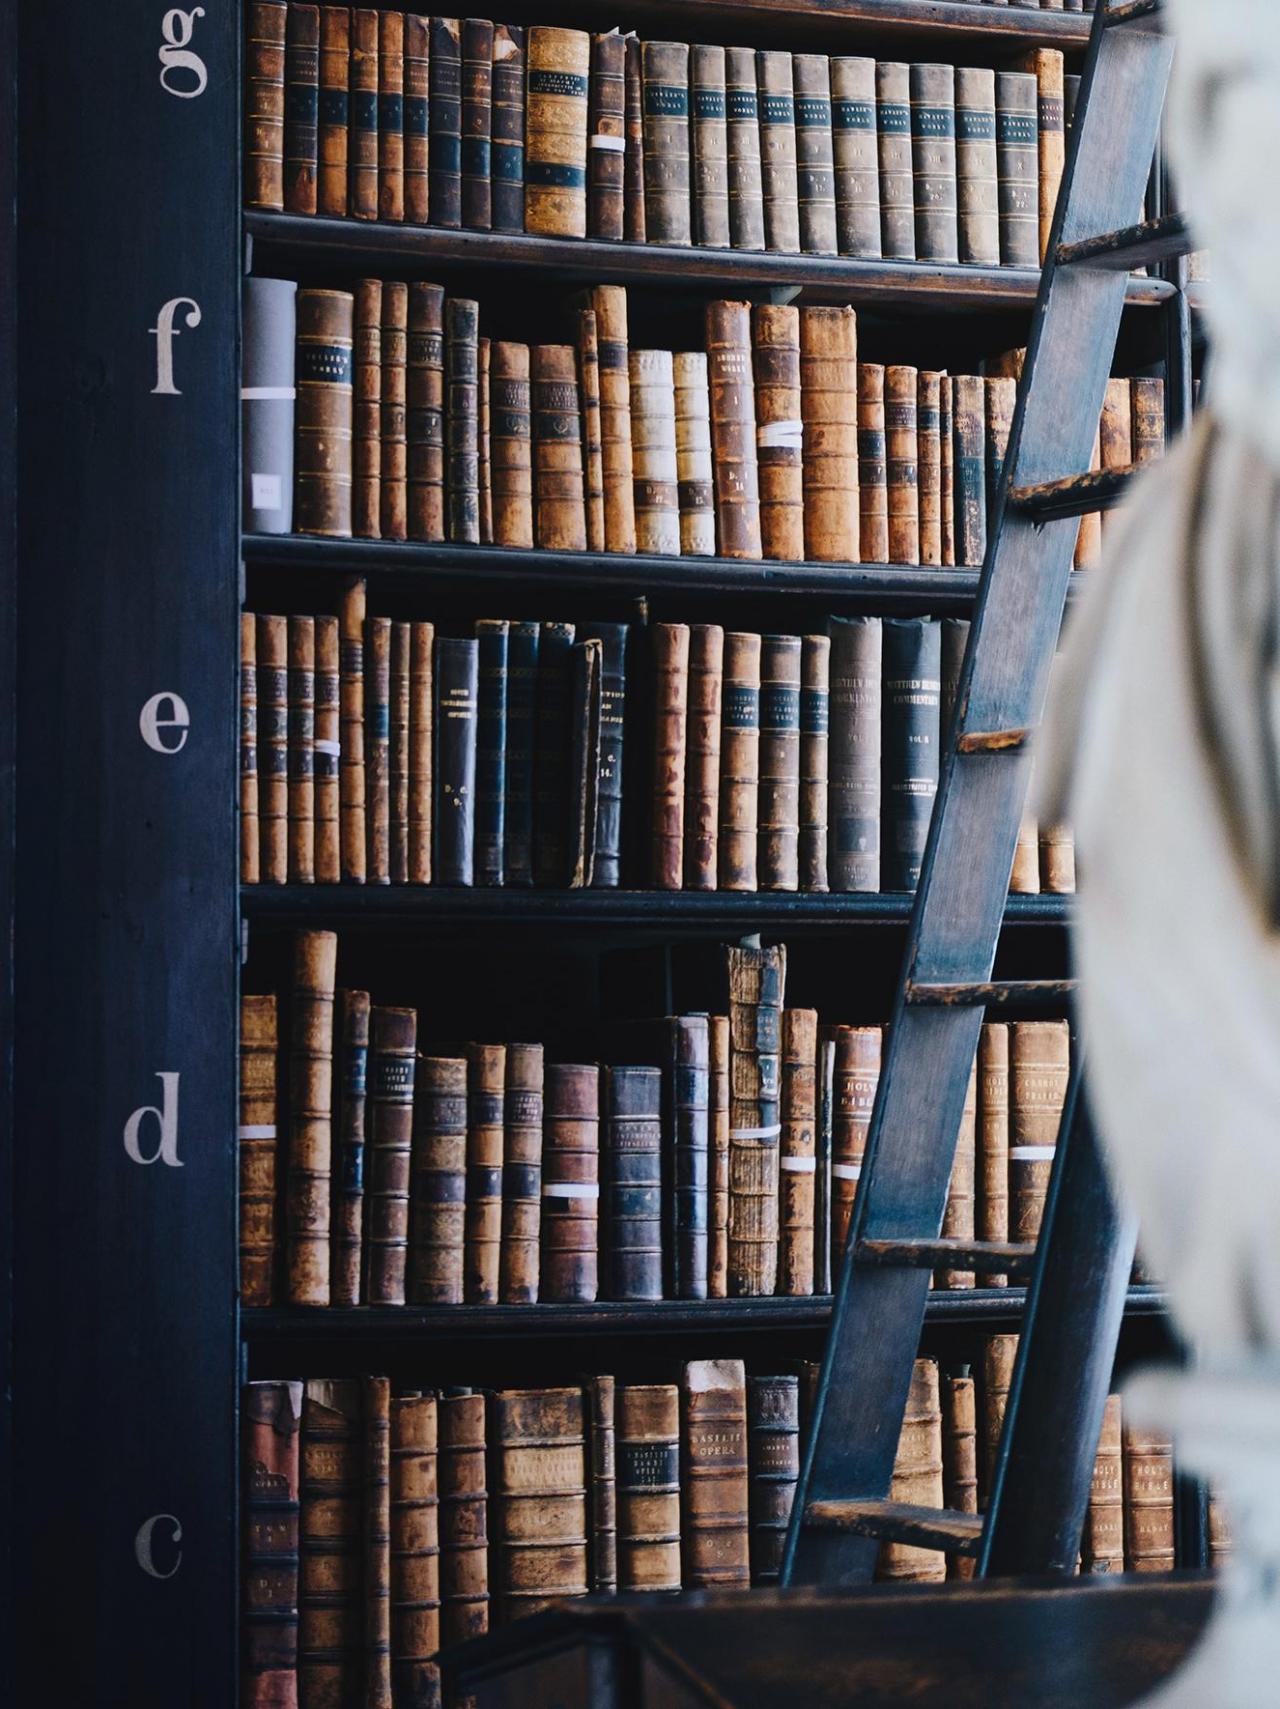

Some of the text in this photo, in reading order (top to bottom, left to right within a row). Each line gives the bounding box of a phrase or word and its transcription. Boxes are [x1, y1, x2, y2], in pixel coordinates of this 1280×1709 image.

[158, 6, 208, 99] g
[148, 297, 201, 395] f
[139, 691, 190, 754] e
[123, 1072, 185, 1167] d
[840, 1096, 873, 1107] BIBL
[847, 1082, 876, 1093] HOLY
[699, 1446, 736, 1456] OPERA
[135, 1514, 182, 1579] c
